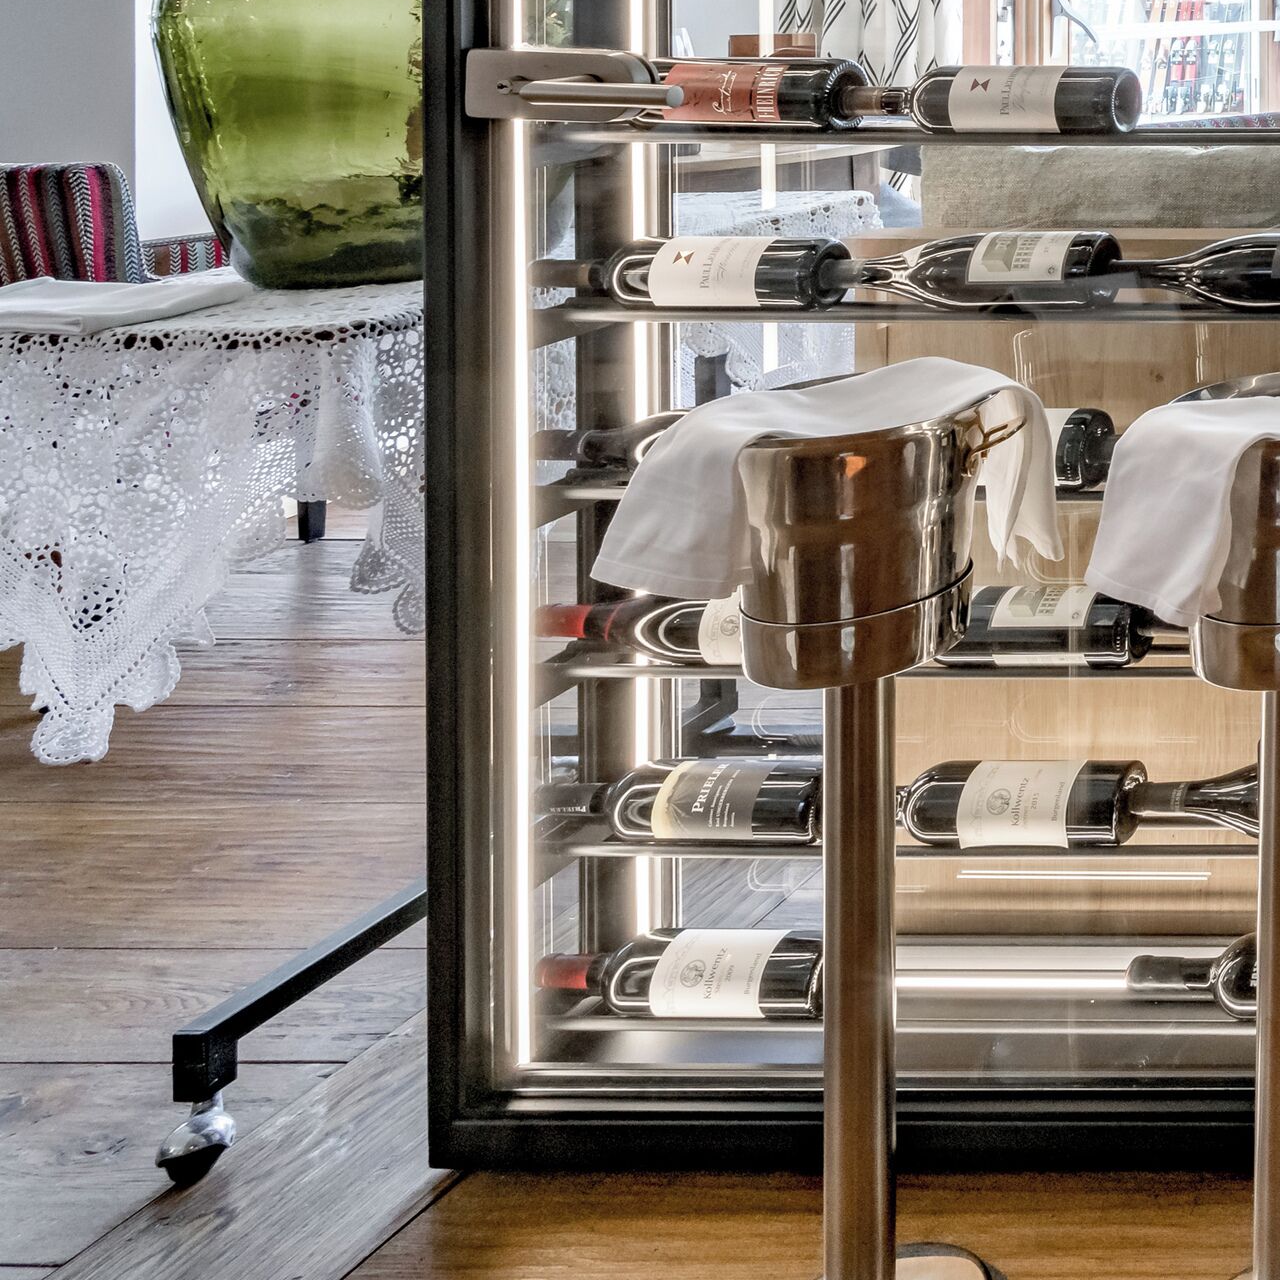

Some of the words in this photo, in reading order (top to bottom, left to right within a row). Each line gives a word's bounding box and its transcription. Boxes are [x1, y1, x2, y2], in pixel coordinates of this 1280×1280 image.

[999, 95, 1011, 116] PAUL
[698, 271, 711, 289] PAUL
[690, 762, 731, 814] PRIELER
[1009, 776, 1031, 827] Kollwentz
[1050, 781, 1066, 822] Burgenland
[703, 946, 728, 1000] Kollwentz
